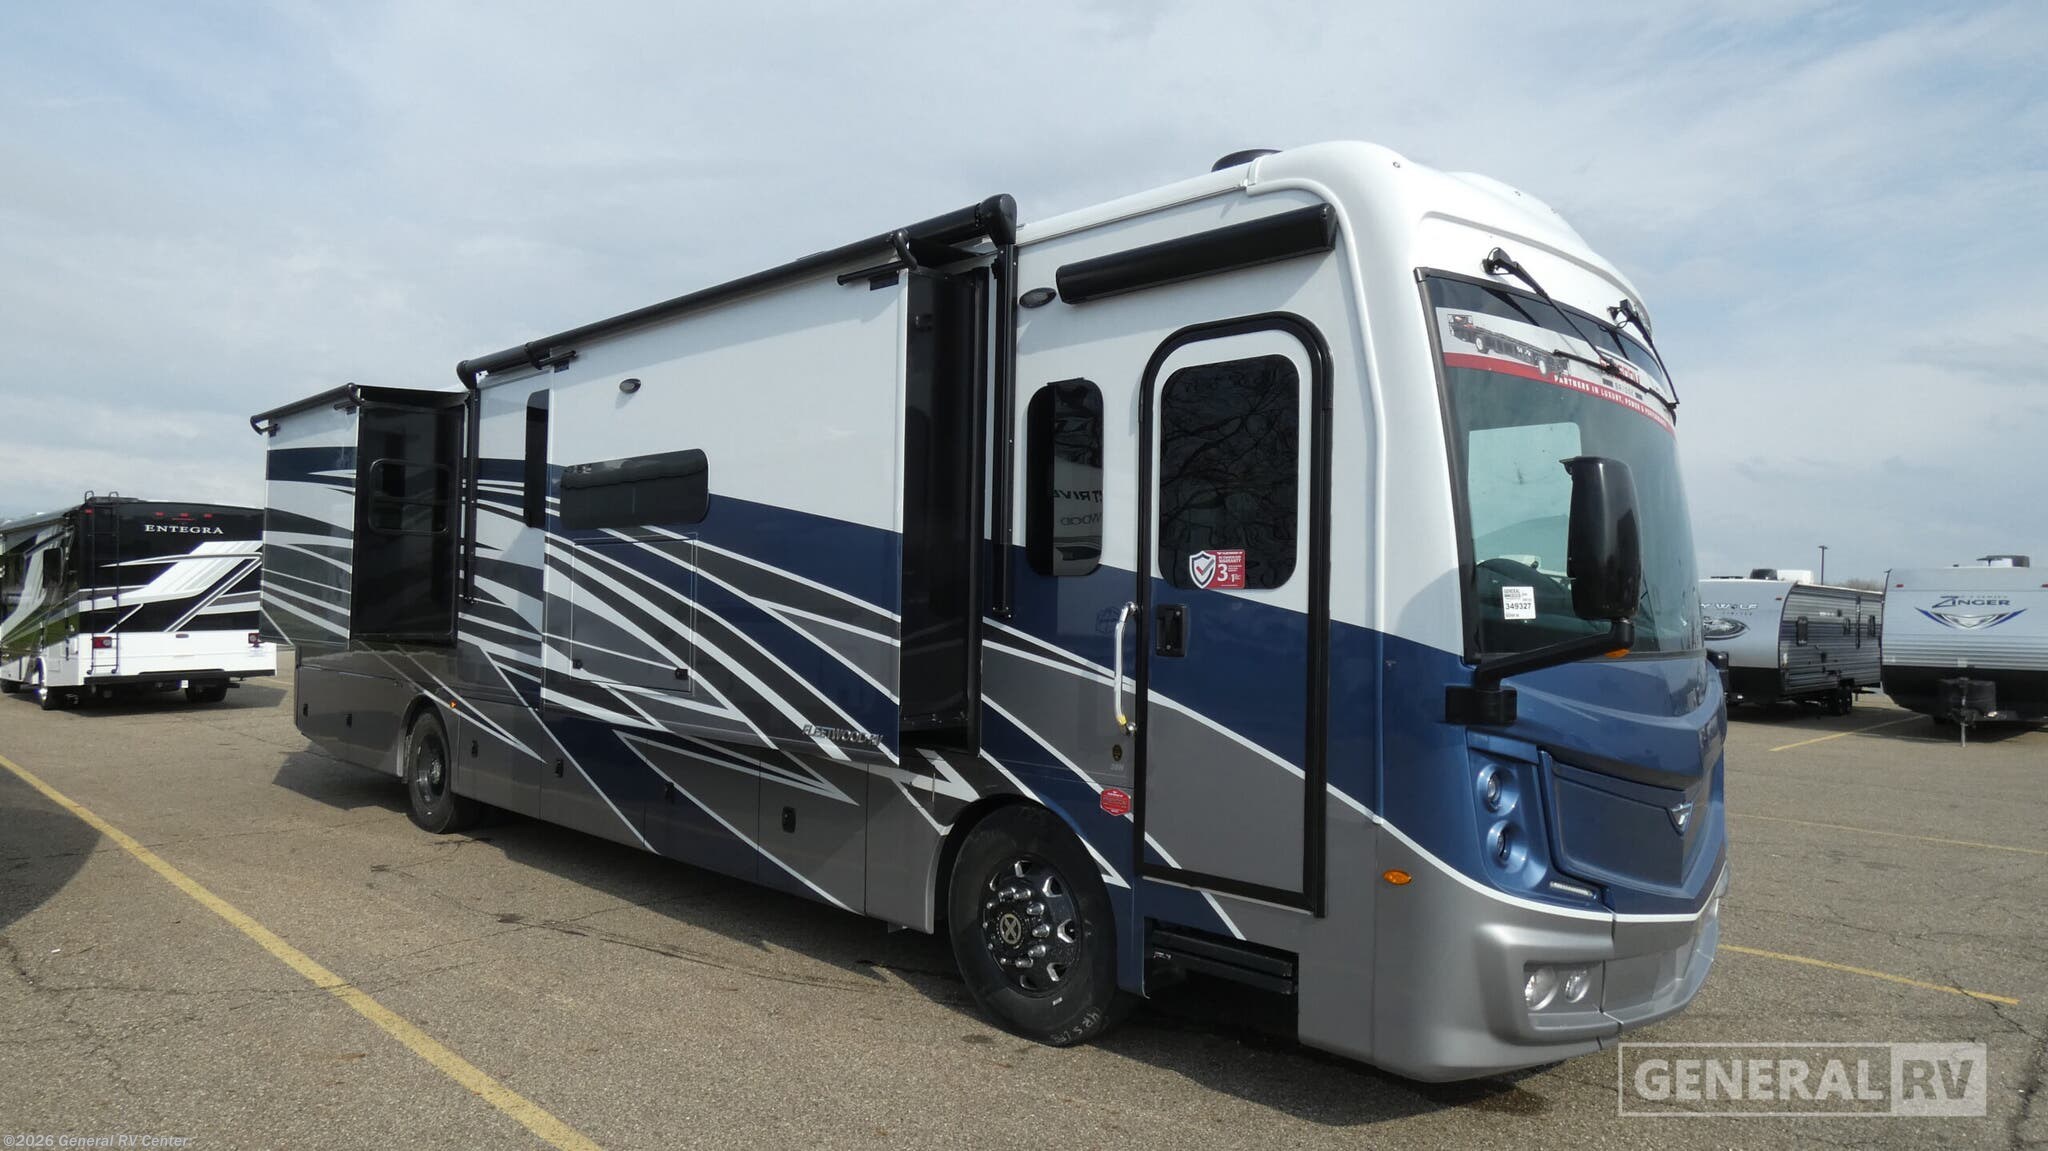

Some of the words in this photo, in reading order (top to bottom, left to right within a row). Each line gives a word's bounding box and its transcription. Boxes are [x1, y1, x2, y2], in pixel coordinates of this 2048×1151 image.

[1554, 375, 1589, 392] PARTNERS
[1591, 386, 1599, 394] IN
[144, 524, 224, 535] ENTEGRA
[1217, 563, 1229, 582] 3
[1505, 602, 1532, 610] 349327
[1931, 595, 2011, 609] ZINGER
[802, 724, 868, 744] FLEETWOOD
